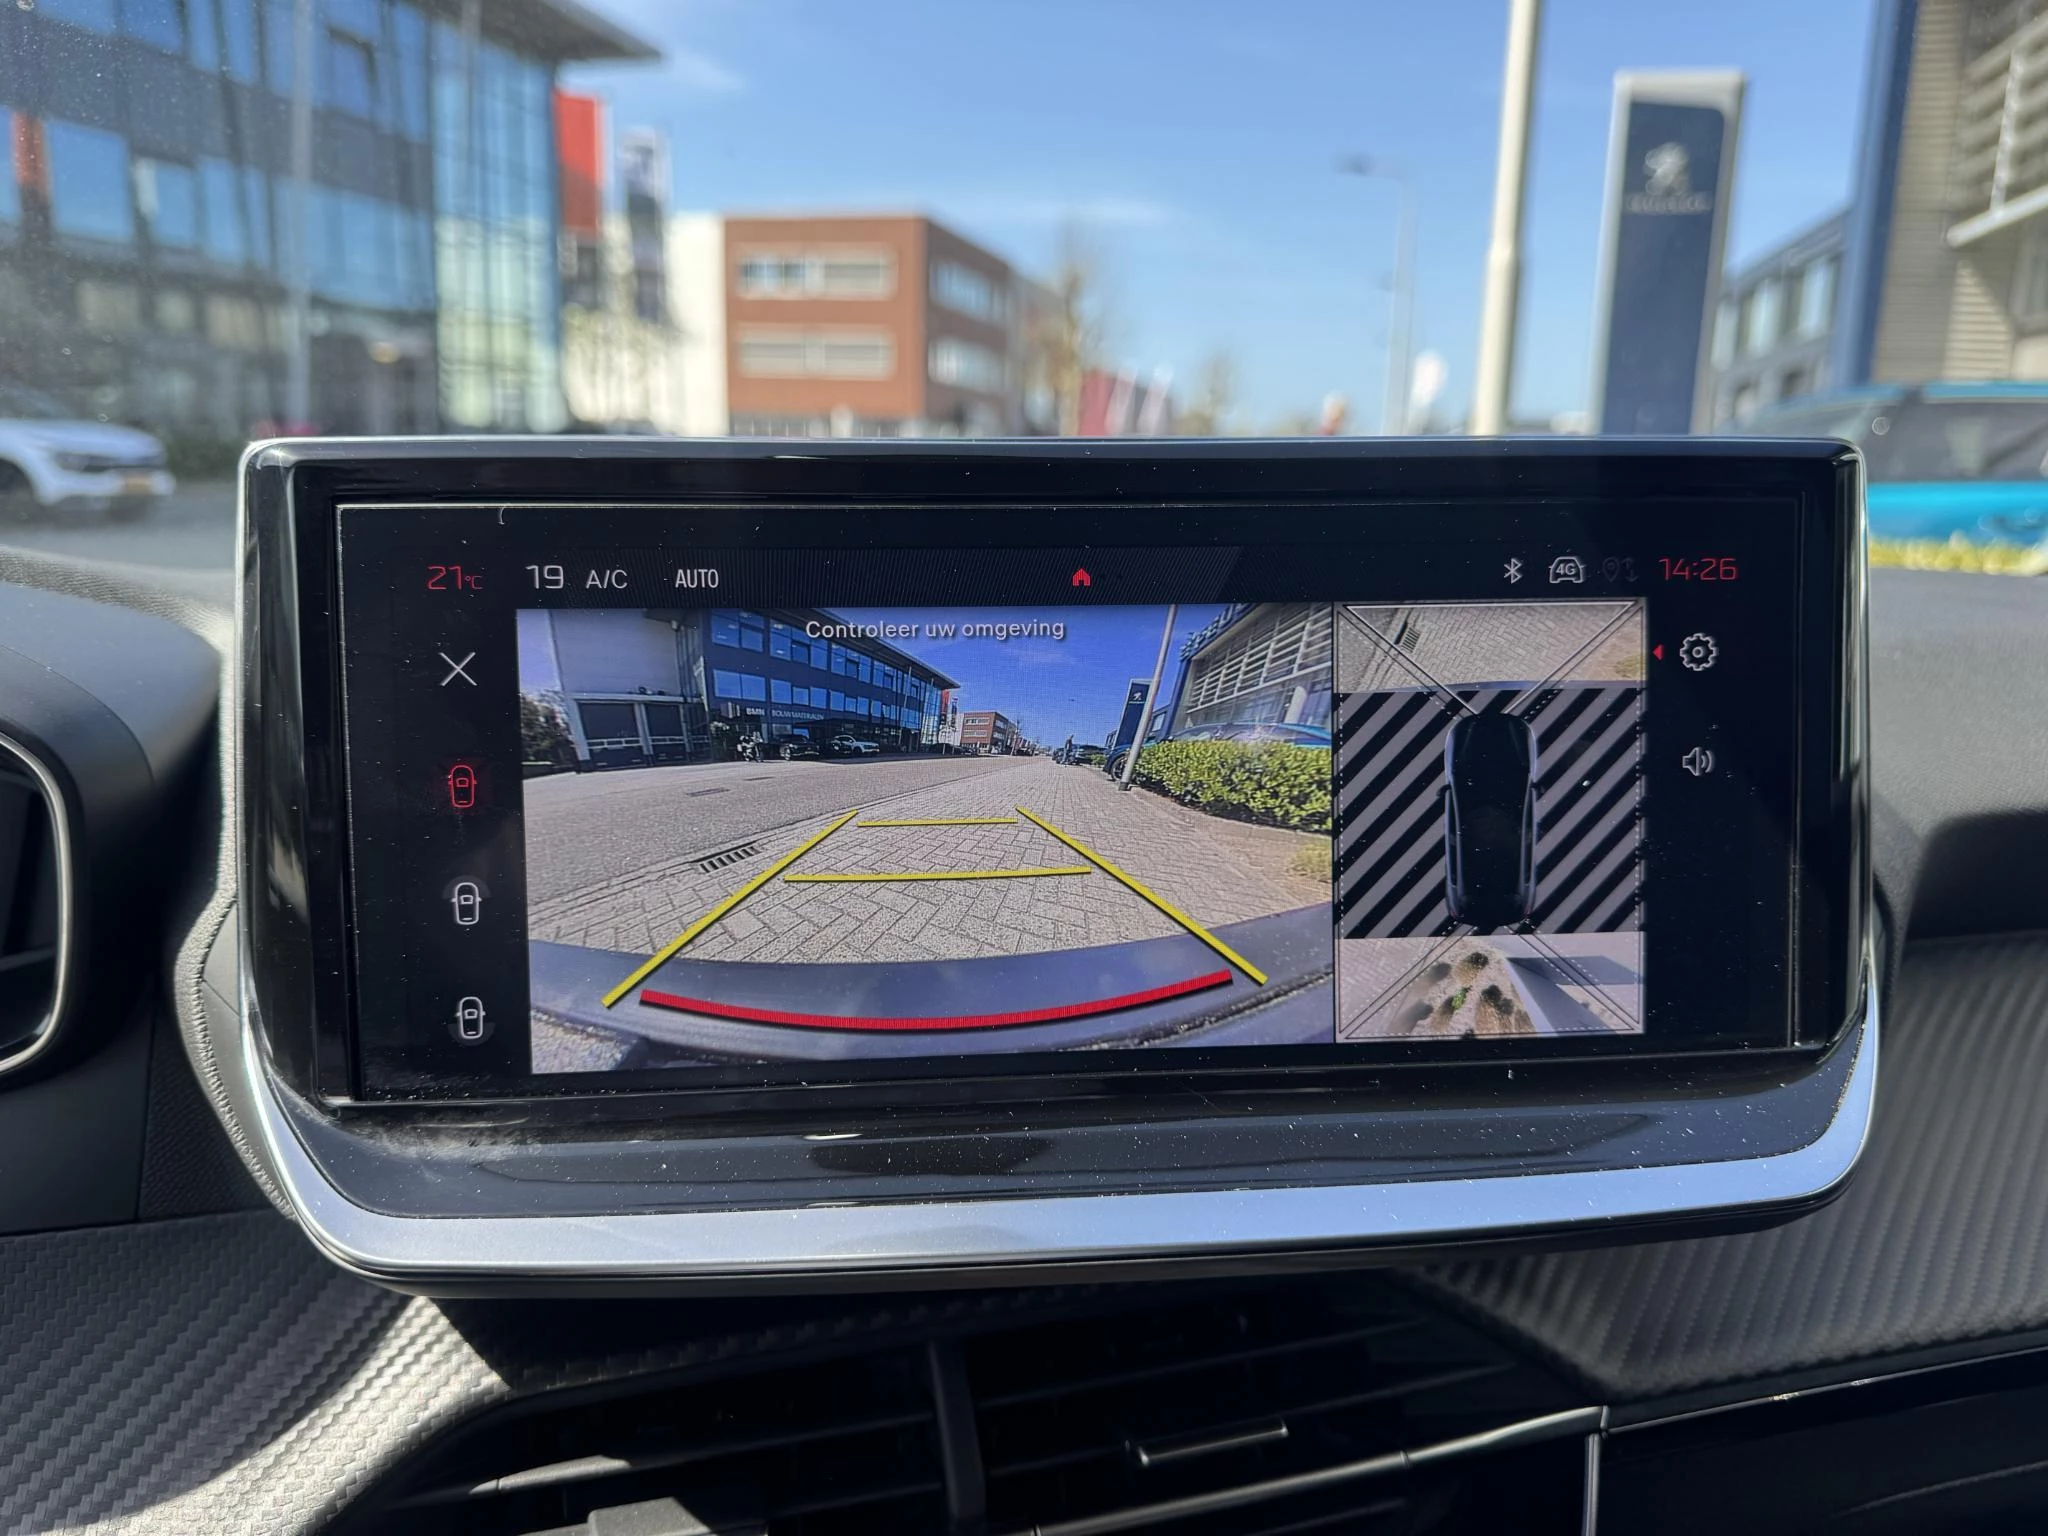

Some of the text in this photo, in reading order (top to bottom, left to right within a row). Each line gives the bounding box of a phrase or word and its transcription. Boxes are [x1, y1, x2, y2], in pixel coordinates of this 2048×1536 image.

[525, 564, 564, 590] 19
[585, 569, 629, 590] A/C
[674, 568, 719, 589] AUTO
[1555, 563, 1575, 576] 4G
[1659, 557, 1738, 581] 14:26
[805, 619, 1066, 641] Controleer uw omgeving
